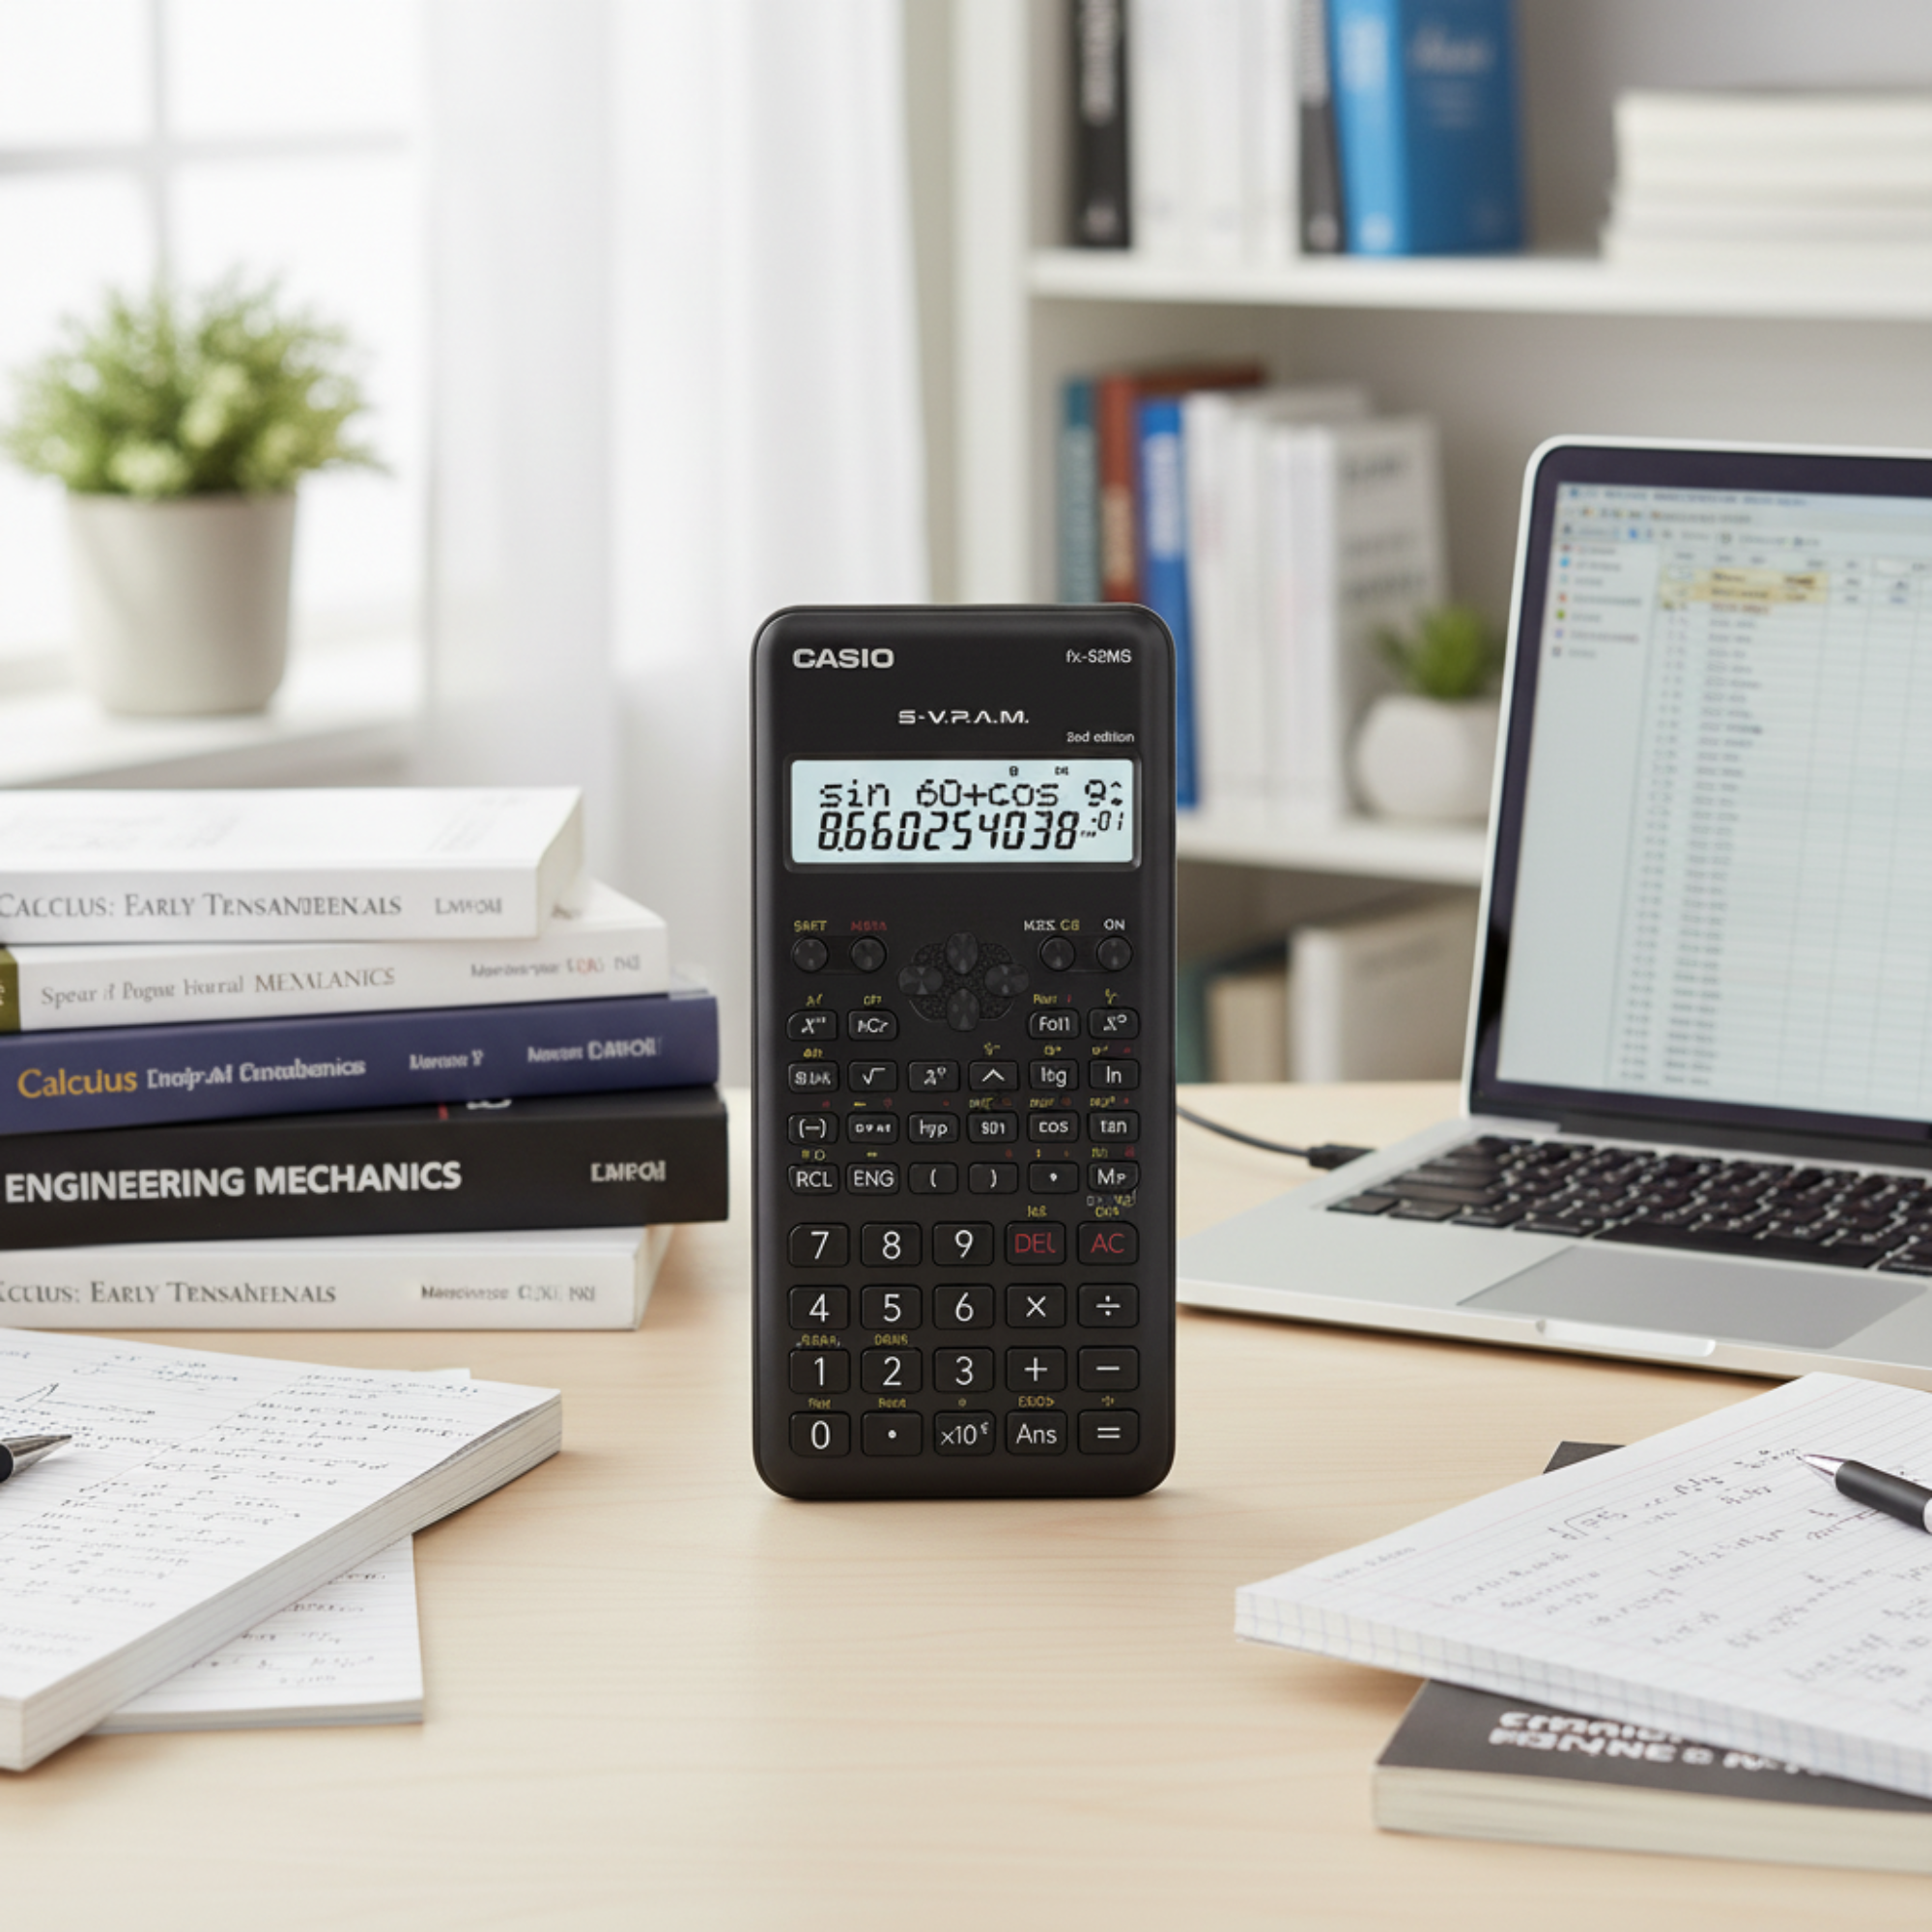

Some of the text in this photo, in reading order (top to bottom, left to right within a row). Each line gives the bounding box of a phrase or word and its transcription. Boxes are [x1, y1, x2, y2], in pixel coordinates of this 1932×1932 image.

[793, 648, 895, 668] CASIO
[1094, 731, 1135, 743] edition
[819, 779, 890, 808] sin
[1103, 918, 1126, 931] ON
[17, 1067, 138, 1098] Calculus
[919, 1119, 949, 1139] hyp
[1038, 1121, 1069, 1134] cos
[1099, 1120, 1128, 1134] tan
[4, 1160, 463, 1204] ENGINEERING MECHANICS
[795, 1170, 834, 1188] RCL
[853, 1169, 895, 1188] ENG
[810, 1231, 830, 1260] 7
[882, 1231, 901, 1260] 8
[954, 1230, 974, 1259] 9
[1090, 1233, 1125, 1255] AC
[809, 1293, 830, 1322] 4
[882, 1293, 902, 1322] 5
[954, 1293, 975, 1322] 6
[813, 1356, 825, 1386] 1
[882, 1356, 902, 1386] 2
[954, 1356, 974, 1386] 3
[810, 1420, 831, 1450] 0
[1016, 1423, 1058, 1445] Ans
